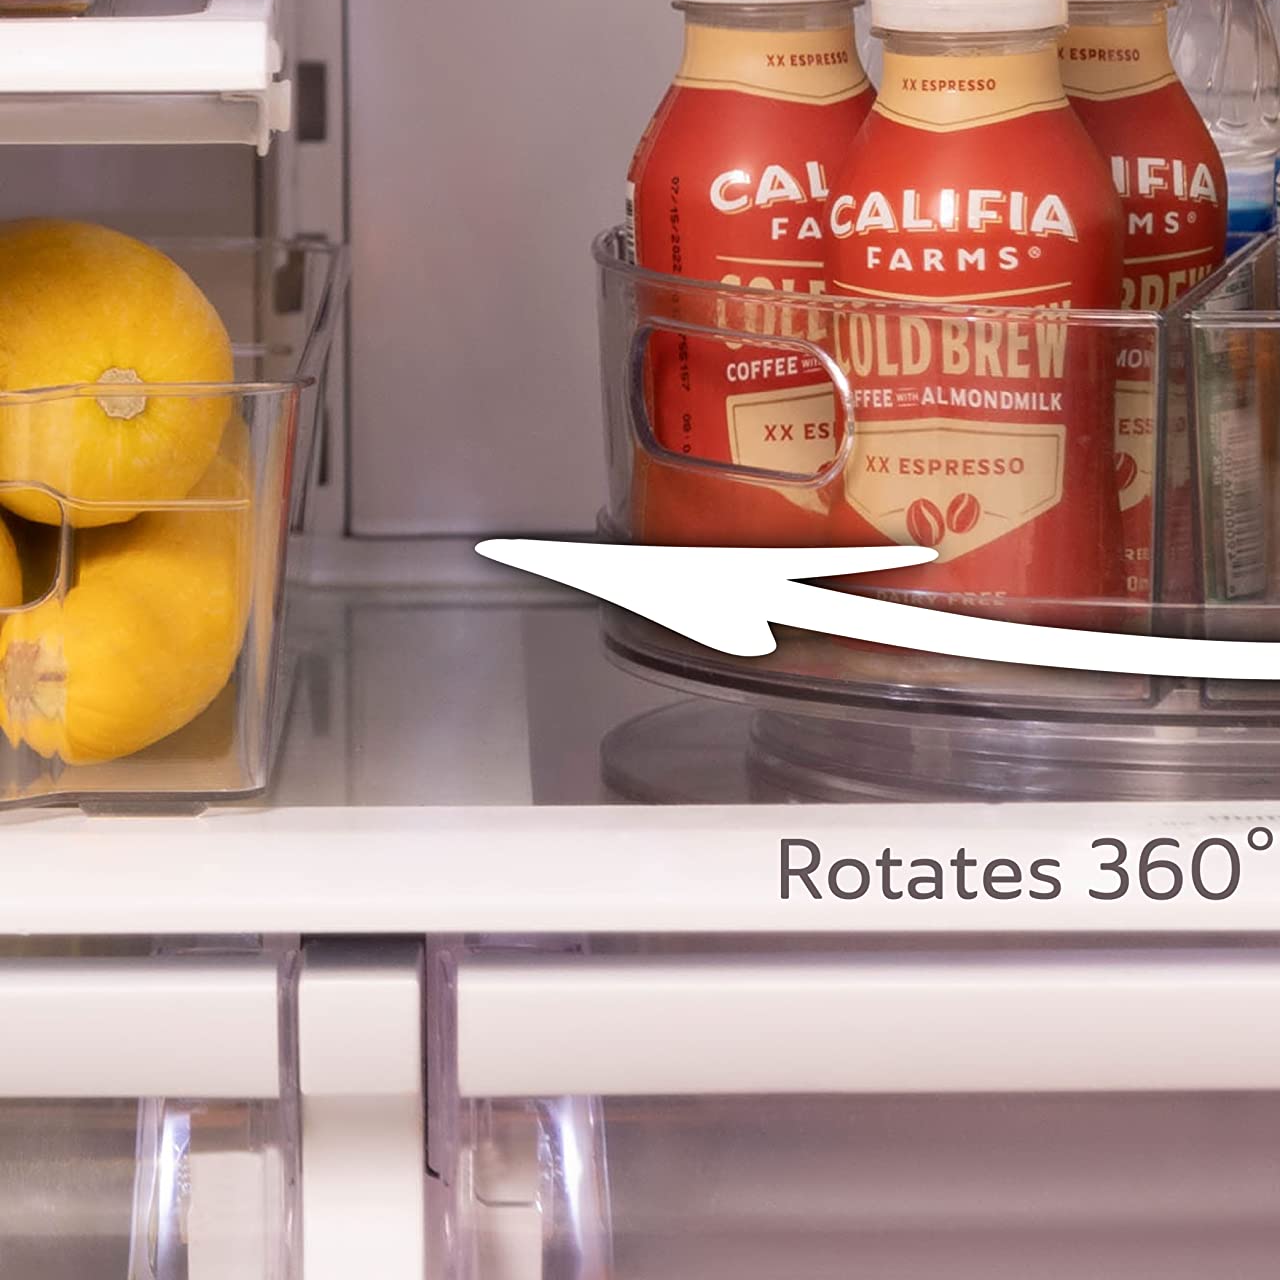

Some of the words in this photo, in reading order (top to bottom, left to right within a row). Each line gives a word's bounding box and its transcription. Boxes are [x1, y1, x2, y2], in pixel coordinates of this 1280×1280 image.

[766, 54, 785, 67] XX
[790, 51, 848, 66] ESPRESSO
[1070, 47, 1140, 61] ESPRESSO
[902, 78, 917, 90] XX
[921, 78, 996, 91] ESPRESSO
[710, 161, 830, 214] CAL
[1111, 156, 1218, 207] IFIA
[830, 188, 1078, 243] CALIFIA
[771, 217, 823, 240] FA
[832, 300, 932, 378] COLD
[942, 300, 1071, 379] BREW
[727, 356, 798, 382] COFFEE
[896, 391, 919, 402] WITH
[921, 385, 1062, 411] ALMONDMILK
[764, 424, 793, 441] XX
[804, 422, 835, 440] ES
[866, 455, 889, 474] XX
[900, 457, 1025, 476] ESPRESSO
[876, 590, 937, 605] DAIRY
[948, 591, 1007, 606] FREE
